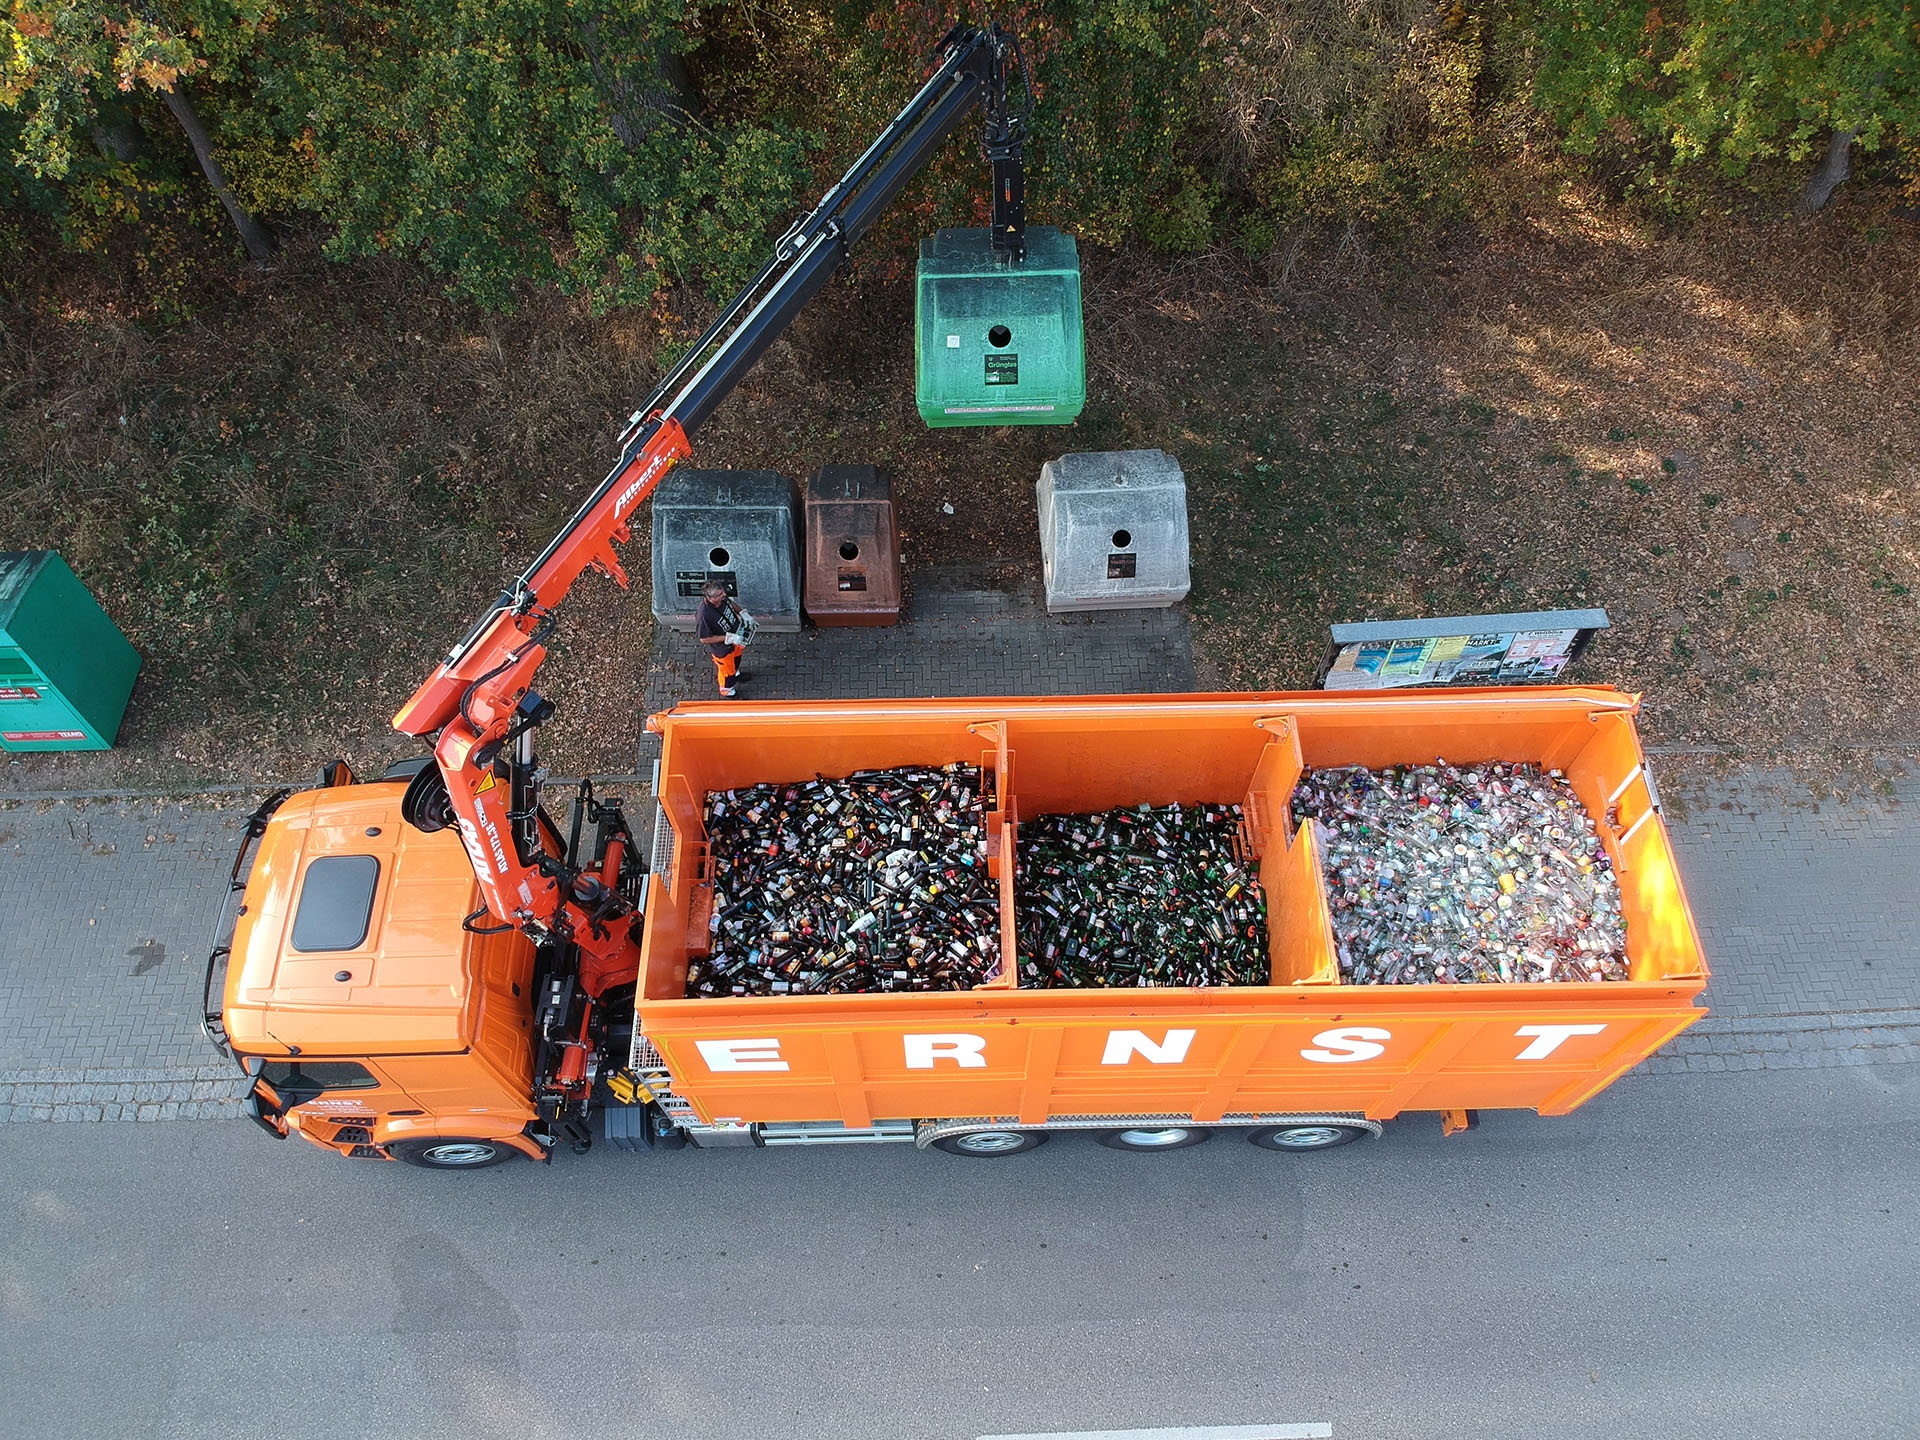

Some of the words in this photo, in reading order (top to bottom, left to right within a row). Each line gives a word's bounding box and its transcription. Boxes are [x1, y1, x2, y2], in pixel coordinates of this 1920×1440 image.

[988, 361, 1017, 369] Grünglas
[614, 454, 662, 520] Albert
[492, 845, 509, 874] ATLAS
[694, 1023, 1608, 1073] ERNST
